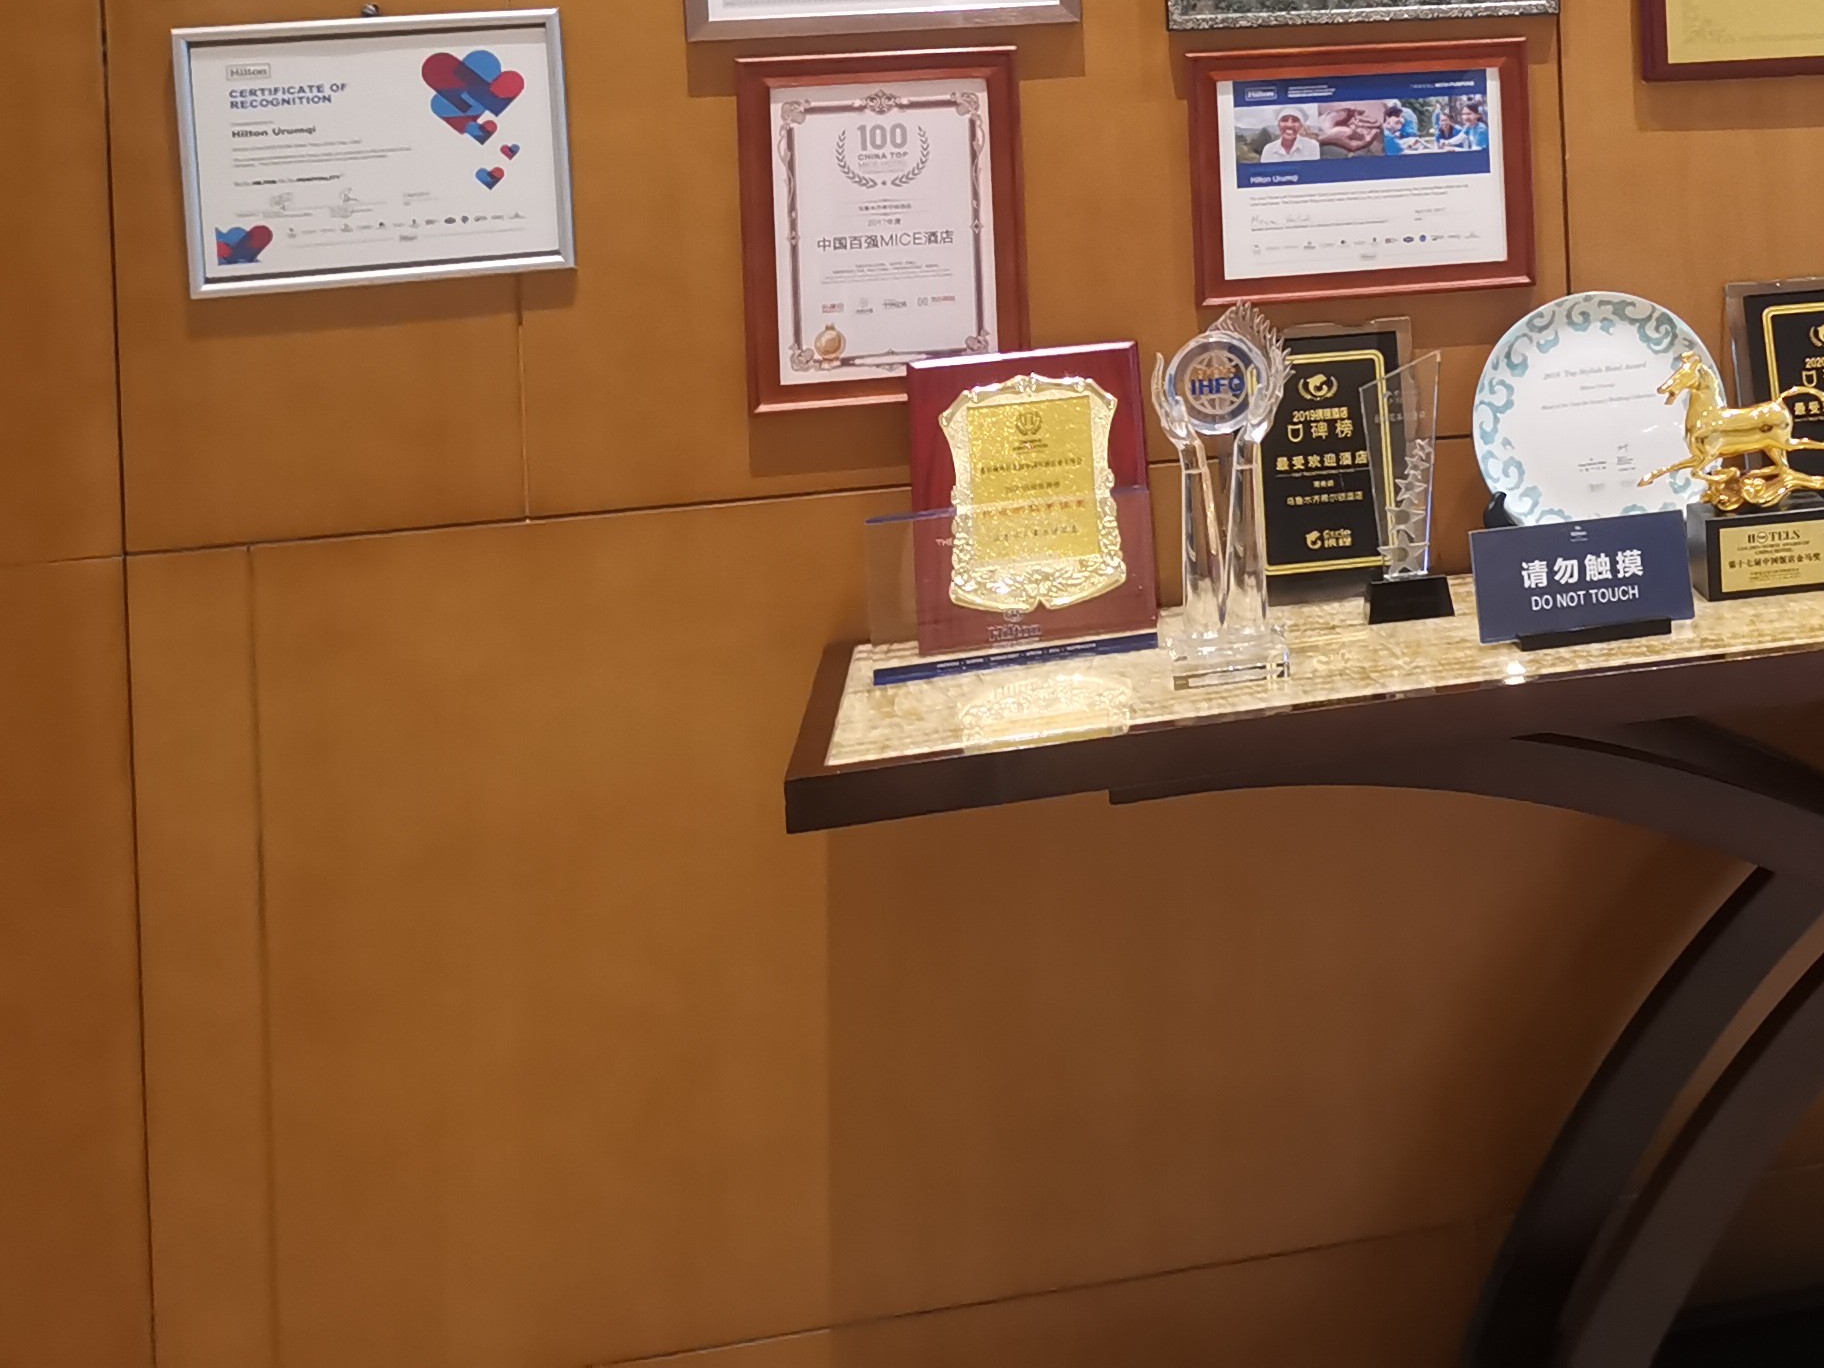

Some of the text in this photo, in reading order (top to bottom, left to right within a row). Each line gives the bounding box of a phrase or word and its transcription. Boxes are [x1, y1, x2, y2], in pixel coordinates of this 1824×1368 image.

[229, 66, 269, 79] Hilton
[229, 82, 348, 100] CERTIFICATE OF
[229, 95, 333, 110] RECOGNITION
[231, 125, 317, 139] Hilton Urumqi
[857, 122, 909, 152] 100
[857, 150, 909, 162] CHINA TOP
[816, 230, 955, 252] 中国百强MICE酒店
[1287, 419, 1354, 442] 口碑榜
[1276, 451, 1369, 471] 最受欢迎酒店
[1286, 491, 1363, 506] 乌鲁木齐希尔顿酒店
[1747, 530, 1801, 544] HOTELS
[1521, 549, 1644, 590] 请勿触摸
[1531, 585, 1639, 611] DO NOT TOUCH
